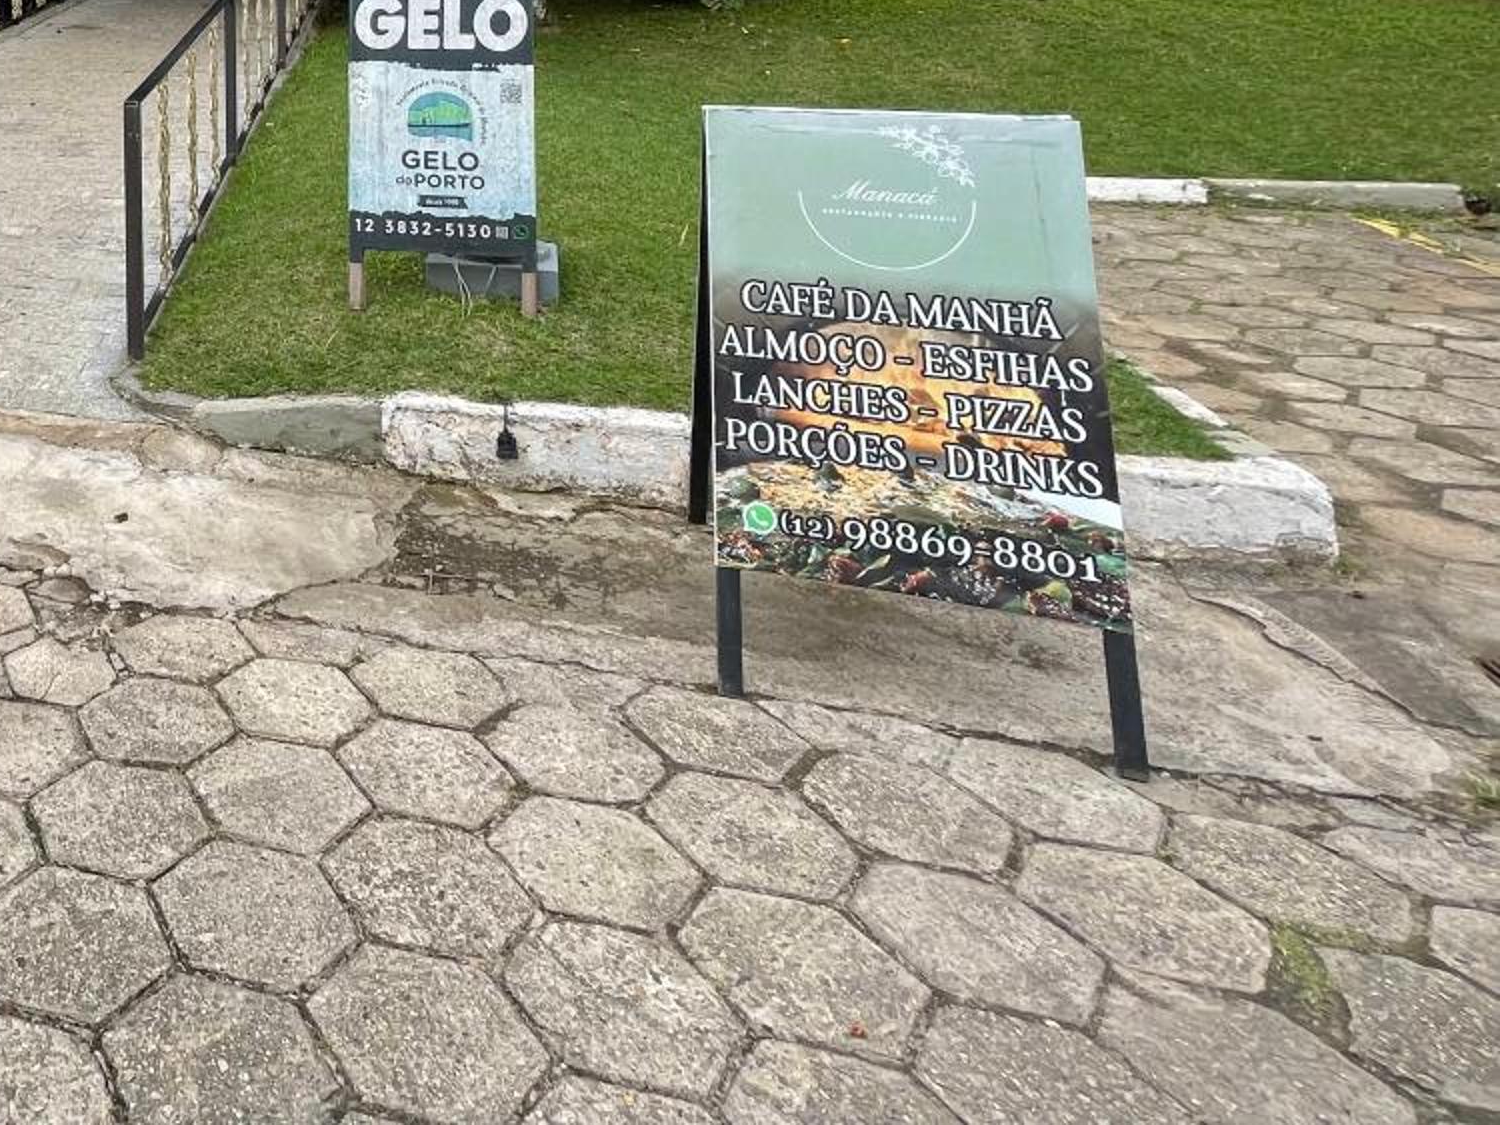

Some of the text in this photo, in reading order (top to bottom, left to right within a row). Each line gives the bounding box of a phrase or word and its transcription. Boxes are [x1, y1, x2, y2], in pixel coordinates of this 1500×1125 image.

[401, 150, 479, 171] GELO
[414, 174, 485, 190] PORTO
[832, 178, 938, 205] Manacá
[355, 218, 491, 238] 12 3832-5130
[741, 278, 1064, 341] CAFÉ DA MANHÃ
[719, 325, 885, 375] ALMOÇO
[922, 342, 1093, 393] ESFIHAS
[732, 371, 909, 421] LANCHES
[946, 394, 1087, 443] PIZZAS
[724, 417, 908, 471] PORÇÕES
[945, 444, 1103, 497] DRINKS
[780, 510, 1102, 582] (12) 98869-8801
